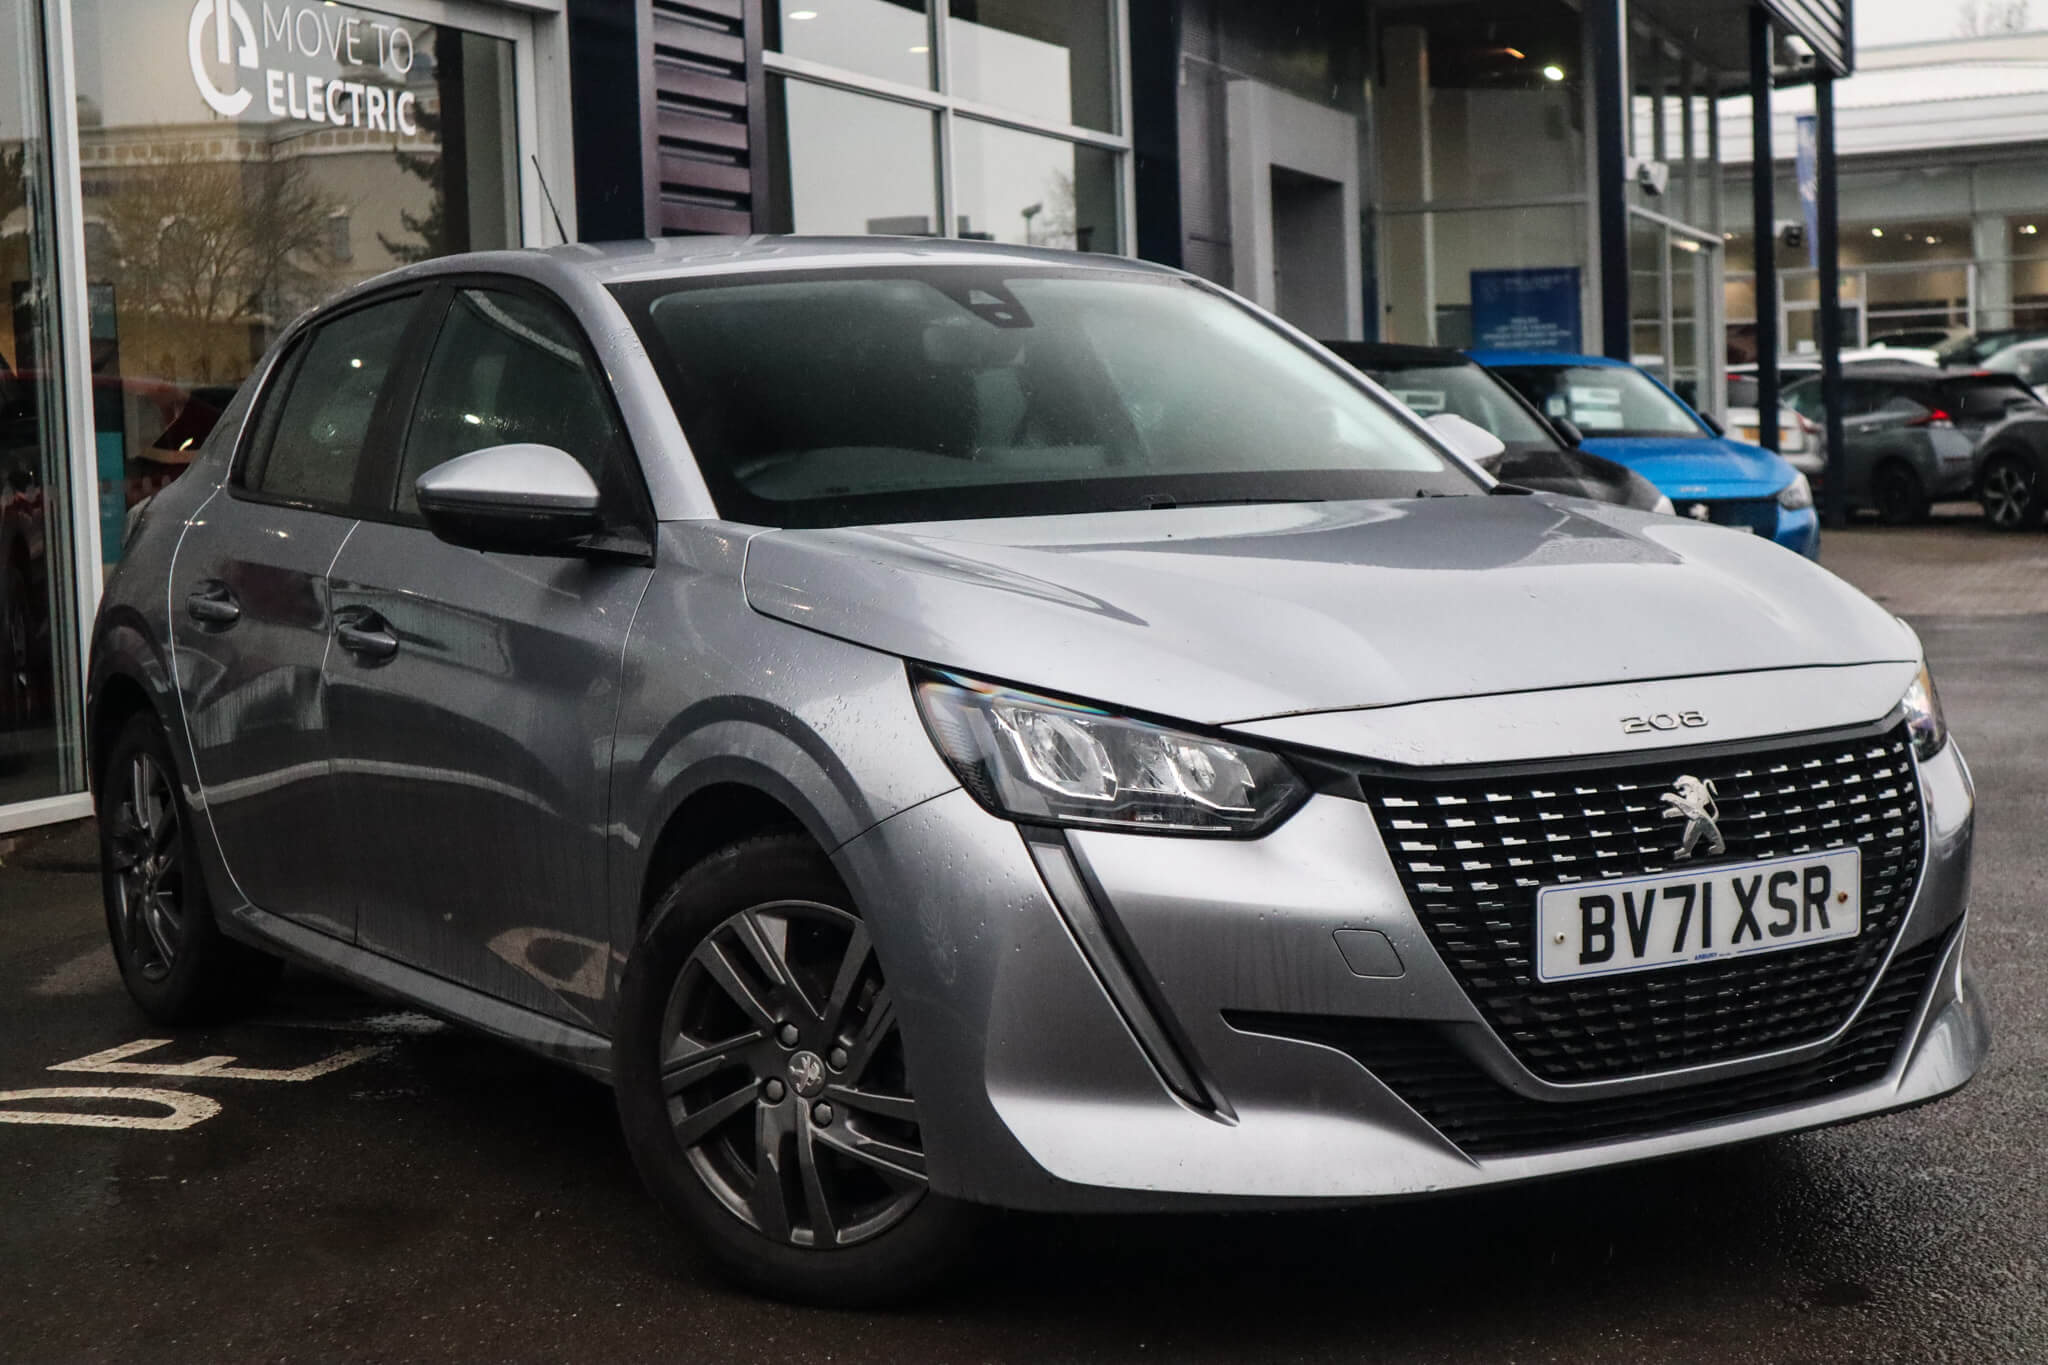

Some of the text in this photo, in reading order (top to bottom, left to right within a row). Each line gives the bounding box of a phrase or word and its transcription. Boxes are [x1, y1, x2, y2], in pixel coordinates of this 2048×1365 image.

[263, 1, 414, 74] MOVE TO
[266, 69, 417, 136] ELECTRIC
[1620, 711, 1708, 734] 208
[1578, 864, 1832, 966] BV71 XSR
